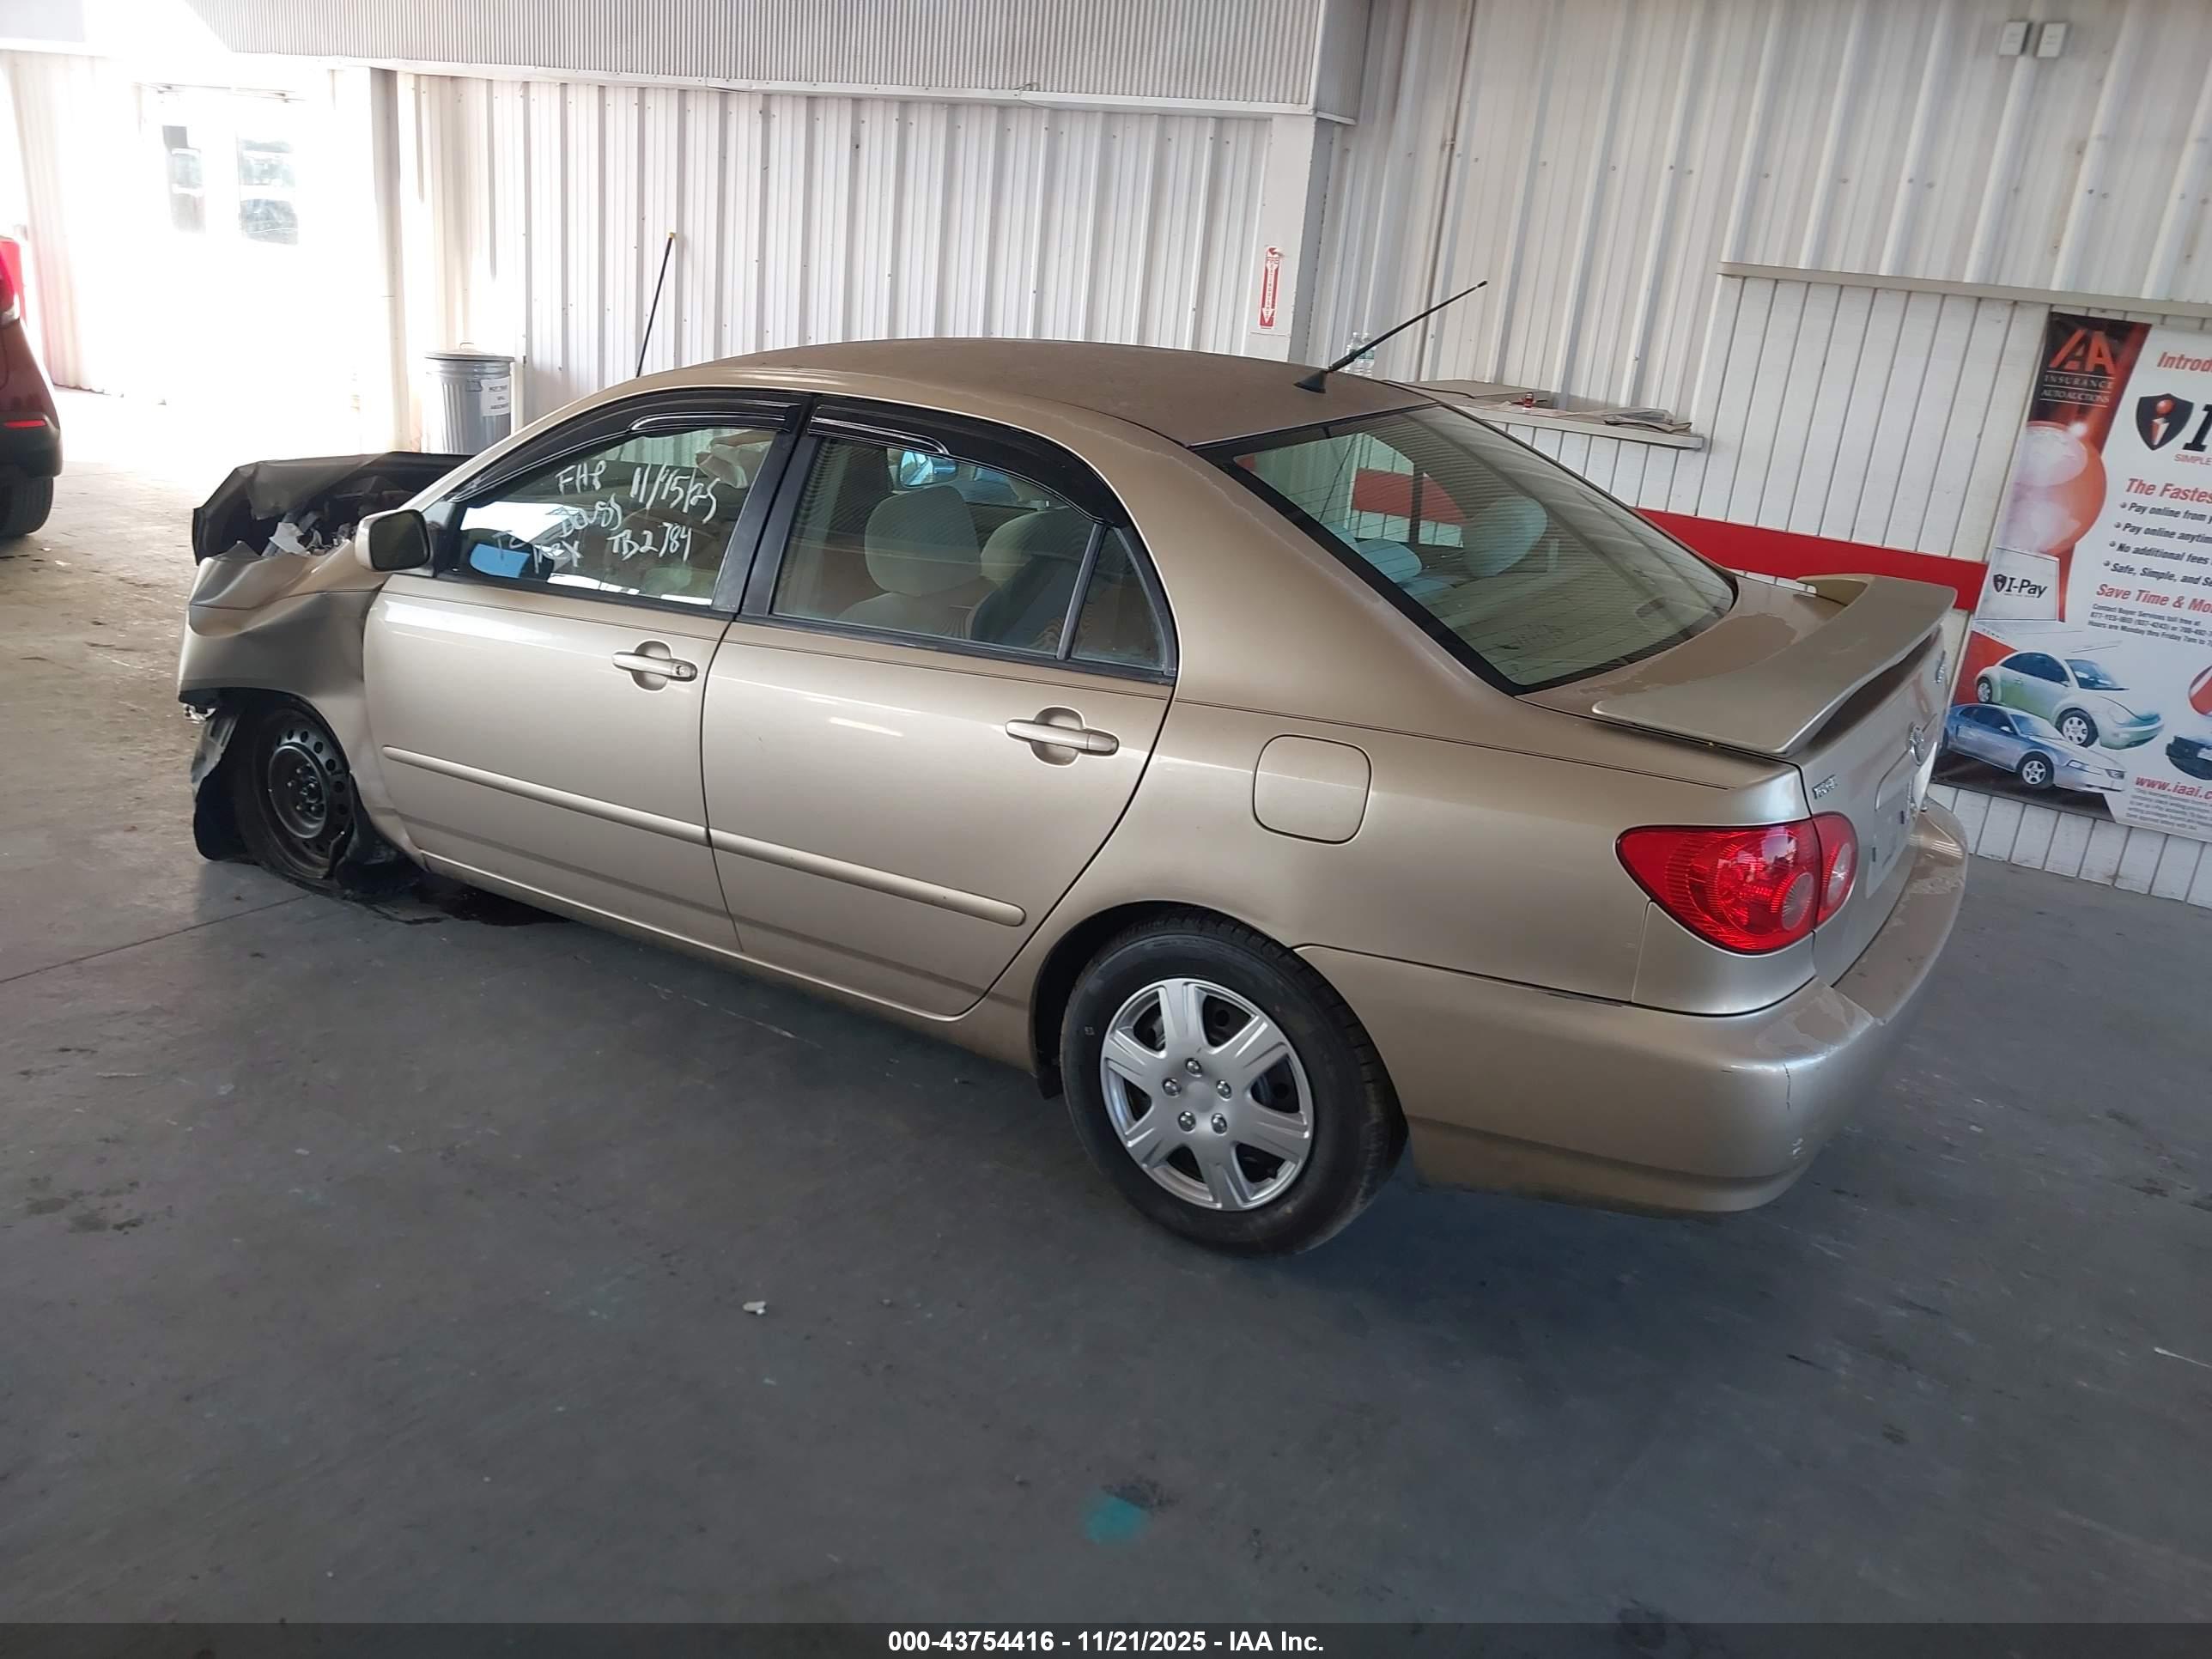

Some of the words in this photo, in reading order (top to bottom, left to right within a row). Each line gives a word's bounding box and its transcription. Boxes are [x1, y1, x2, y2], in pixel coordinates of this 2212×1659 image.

[2045, 374, 2113, 389] INSURANCE
[2126, 477, 2156, 495] The
[2128, 502, 2148, 515] Pay
[2149, 507, 2181, 518] online
[2183, 510, 2207, 522] from
[2122, 522, 2142, 536] Pay
[2143, 526, 2177, 538] online
[2116, 543, 2131, 553] No
[2131, 545, 2186, 562] additional
[2186, 552, 2210, 565] fees
[2111, 562, 2136, 576] Safe,
[2139, 567, 2178, 583] Simple,
[2179, 575, 2203, 585] and
[2006, 576, 2048, 599] I-Pay
[2096, 583, 2132, 600] Save
[2136, 589, 2170, 606] Time
[2172, 595, 2186, 610] &
